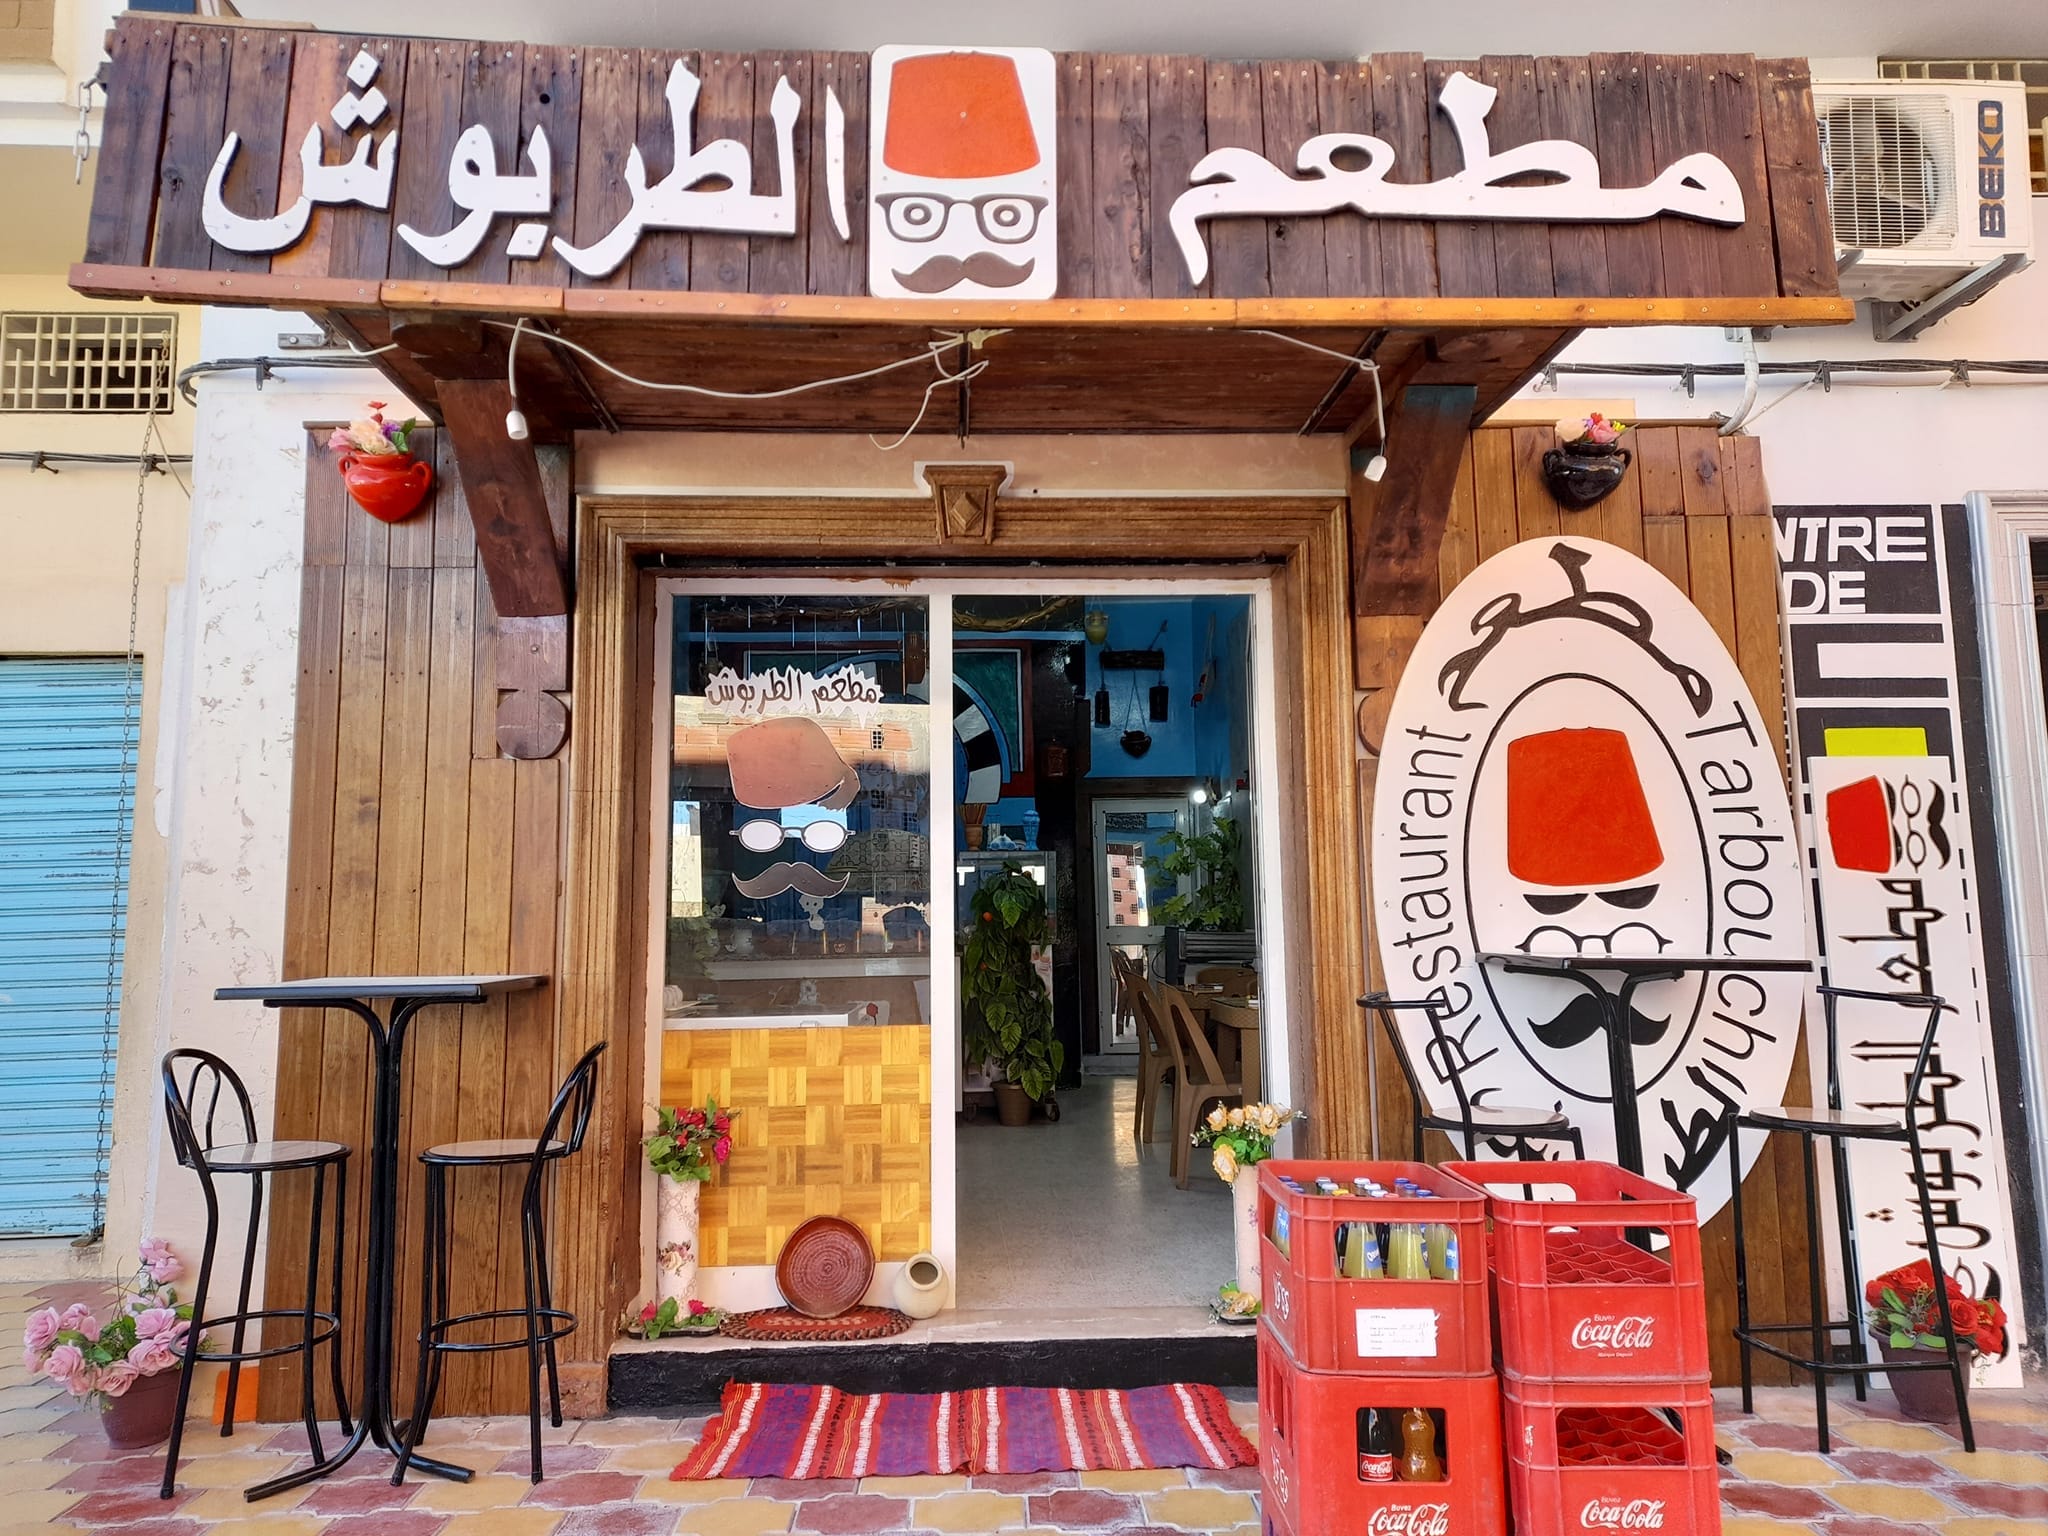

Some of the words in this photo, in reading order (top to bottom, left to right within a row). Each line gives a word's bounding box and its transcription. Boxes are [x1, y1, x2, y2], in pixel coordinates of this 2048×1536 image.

[201, 49, 852, 279] الطربوش
[1169, 71, 1746, 287] مطعم
[1977, 100, 2006, 239] BEKO
[1437, 541, 1713, 719] مطعم
[1782, 571, 1866, 614] DE
[707, 668, 803, 715] الطربوش
[811, 672, 878, 714] مطعم
[1393, 725, 1500, 1085] Restaurant
[1838, 878, 1960, 1016] مطعم
[1850, 1038, 1993, 1251] الطربوش
[1571, 1315, 1656, 1351] Coca-Cola
[1367, 1503, 1450, 1536] Coca-Cola
[1580, 1499, 1666, 1529] Coca-Cola
